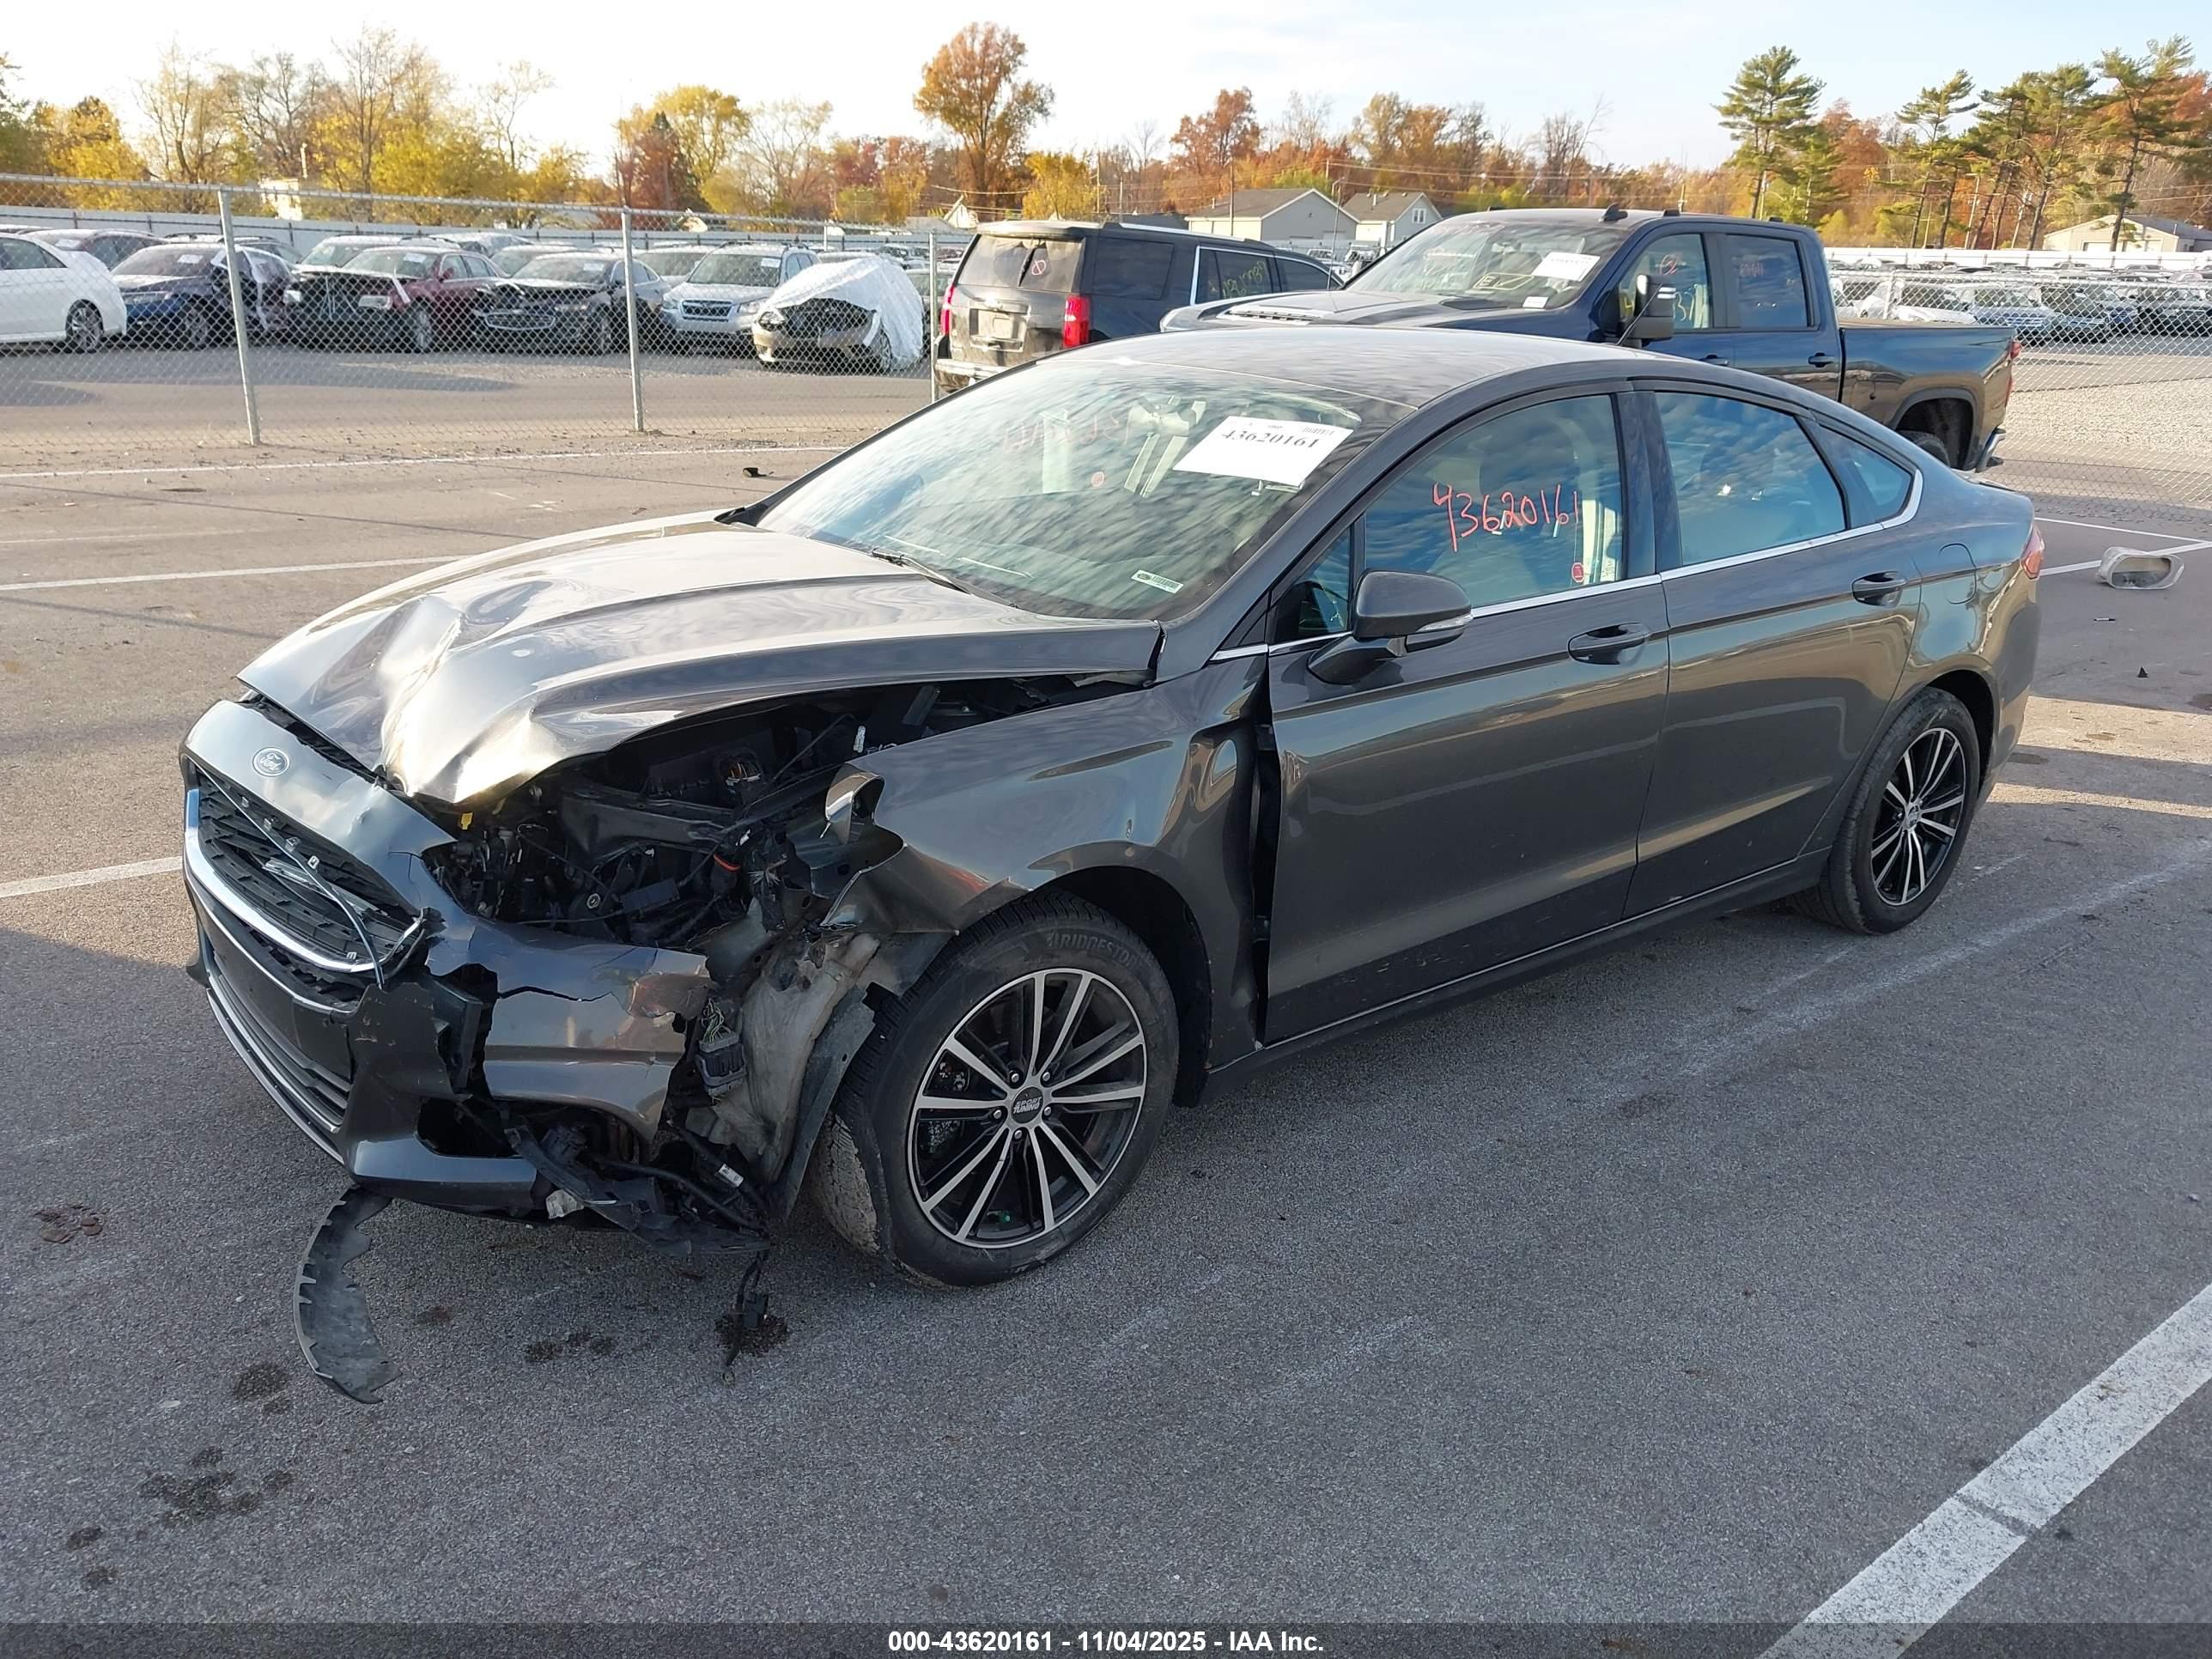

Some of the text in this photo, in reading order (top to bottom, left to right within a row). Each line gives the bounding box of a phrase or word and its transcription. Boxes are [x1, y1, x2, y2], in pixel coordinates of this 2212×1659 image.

[1221, 429, 1320, 448] 43620161
[1432, 481, 1579, 552] 43620161
[1047, 931, 1140, 969] BRIDGESTO
[1015, 1096, 1042, 1109] SPORT
